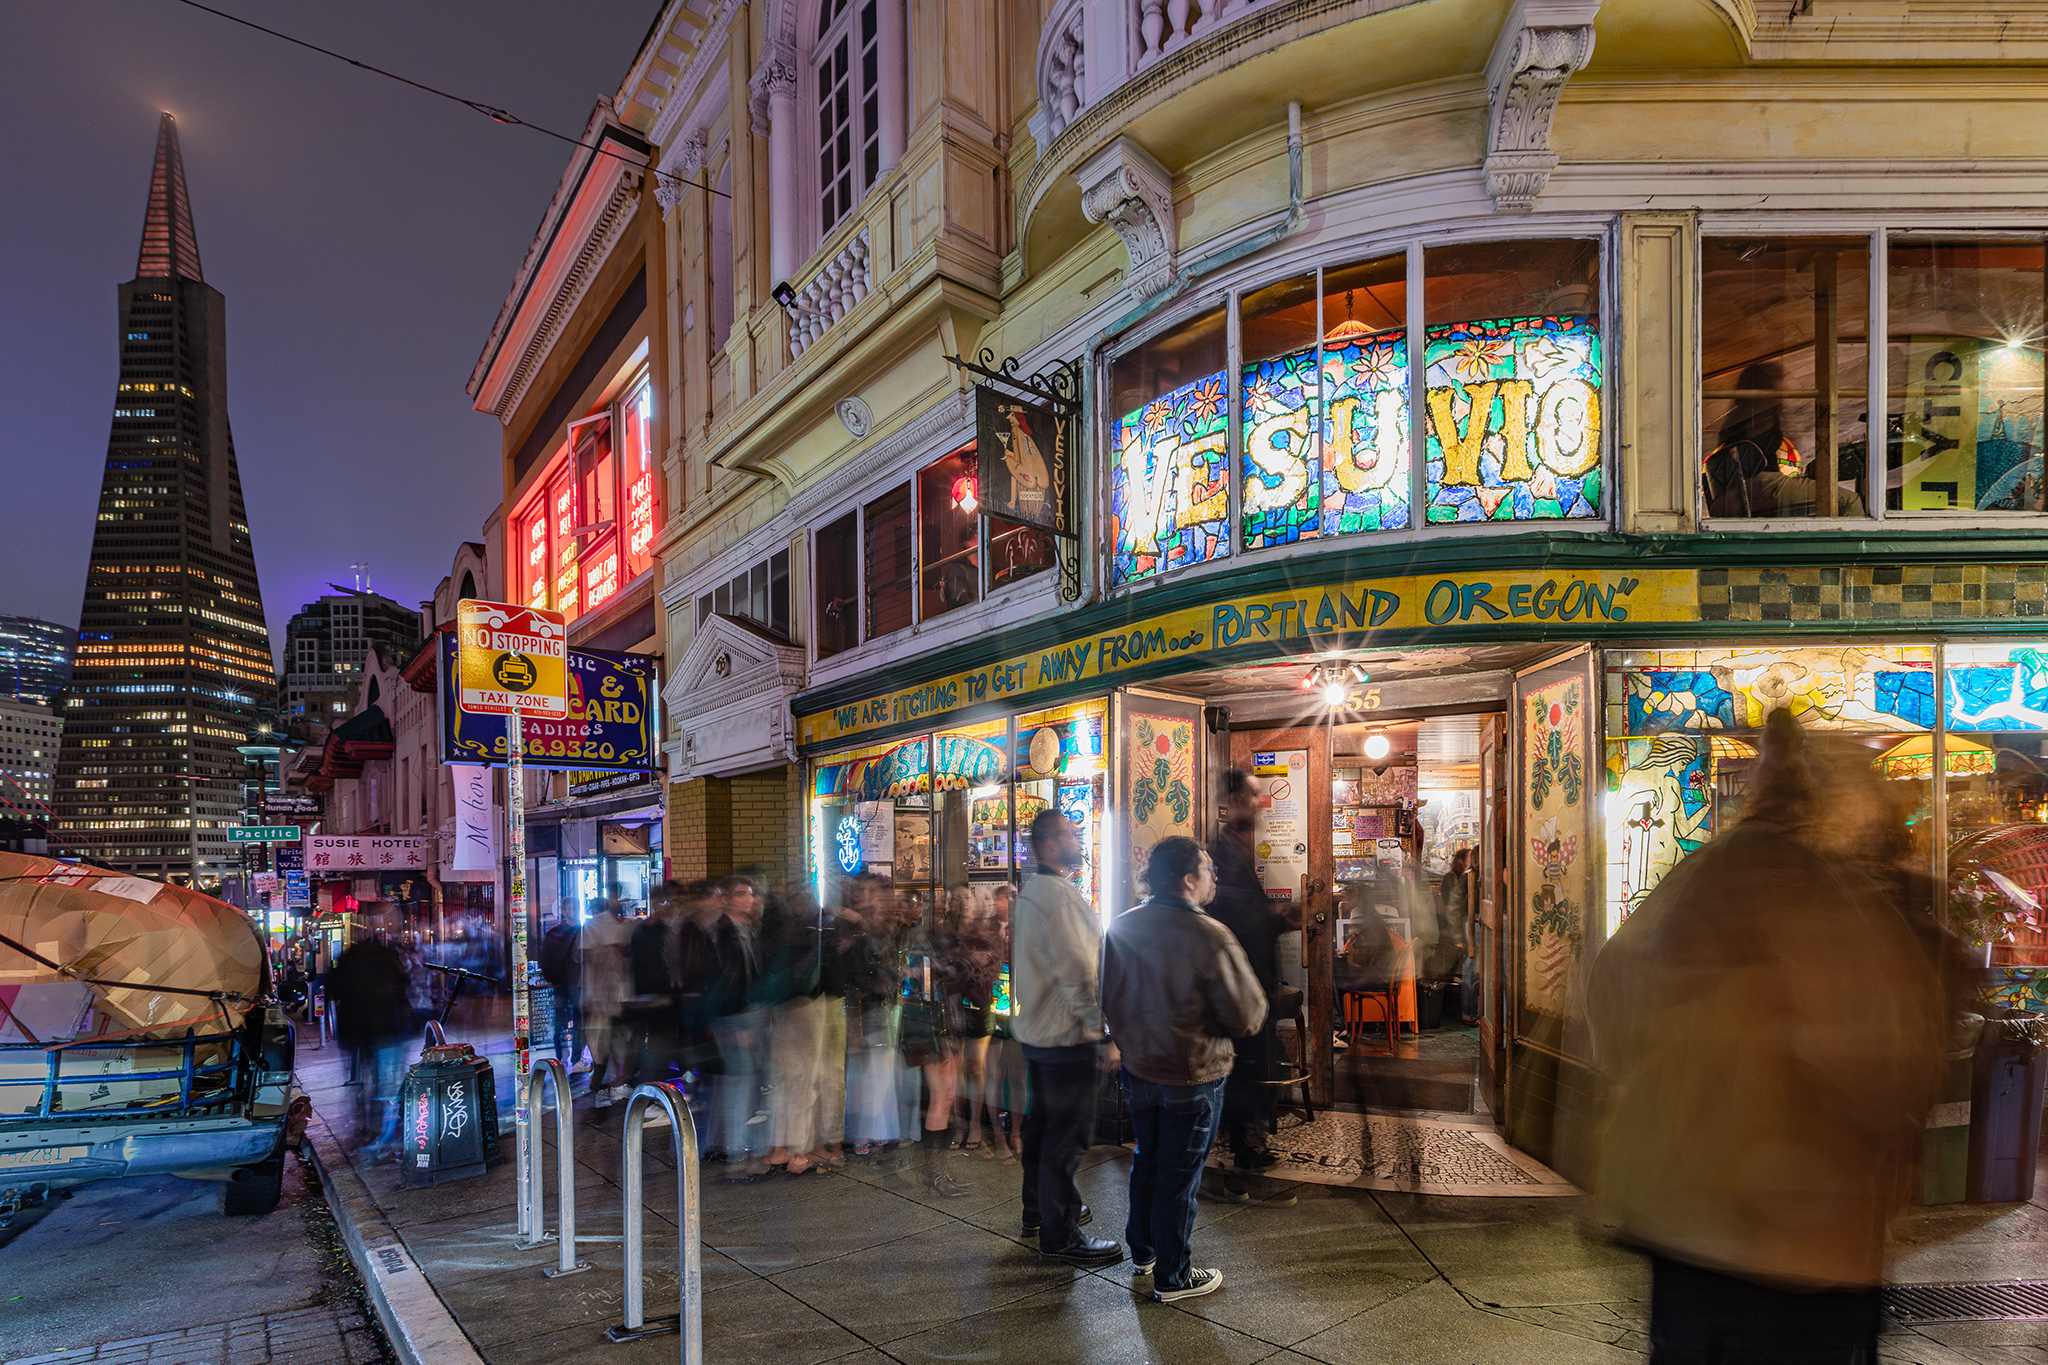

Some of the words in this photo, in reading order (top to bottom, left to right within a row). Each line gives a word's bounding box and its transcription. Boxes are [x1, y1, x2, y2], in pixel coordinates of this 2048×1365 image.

[1053, 415, 1066, 531] VESUVIO
[1120, 377, 1601, 559] VESUVIO
[462, 627, 490, 648] NO
[496, 633, 561, 656] STOPPING
[862, 698, 889, 726] ARE
[963, 674, 987, 701] TO
[991, 661, 1028, 693] GET
[1038, 641, 1091, 685] AWAY
[1212, 587, 1402, 649] PORTLAND
[479, 691, 508, 704] TAXI
[515, 694, 550, 708] ZONE
[1328, 688, 1381, 713] 55
[520, 722, 604, 736] EADINGS
[235, 830, 292, 838] Pacific
[313, 839, 360, 848] SUSIE
[372, 839, 420, 848] HOTEL
